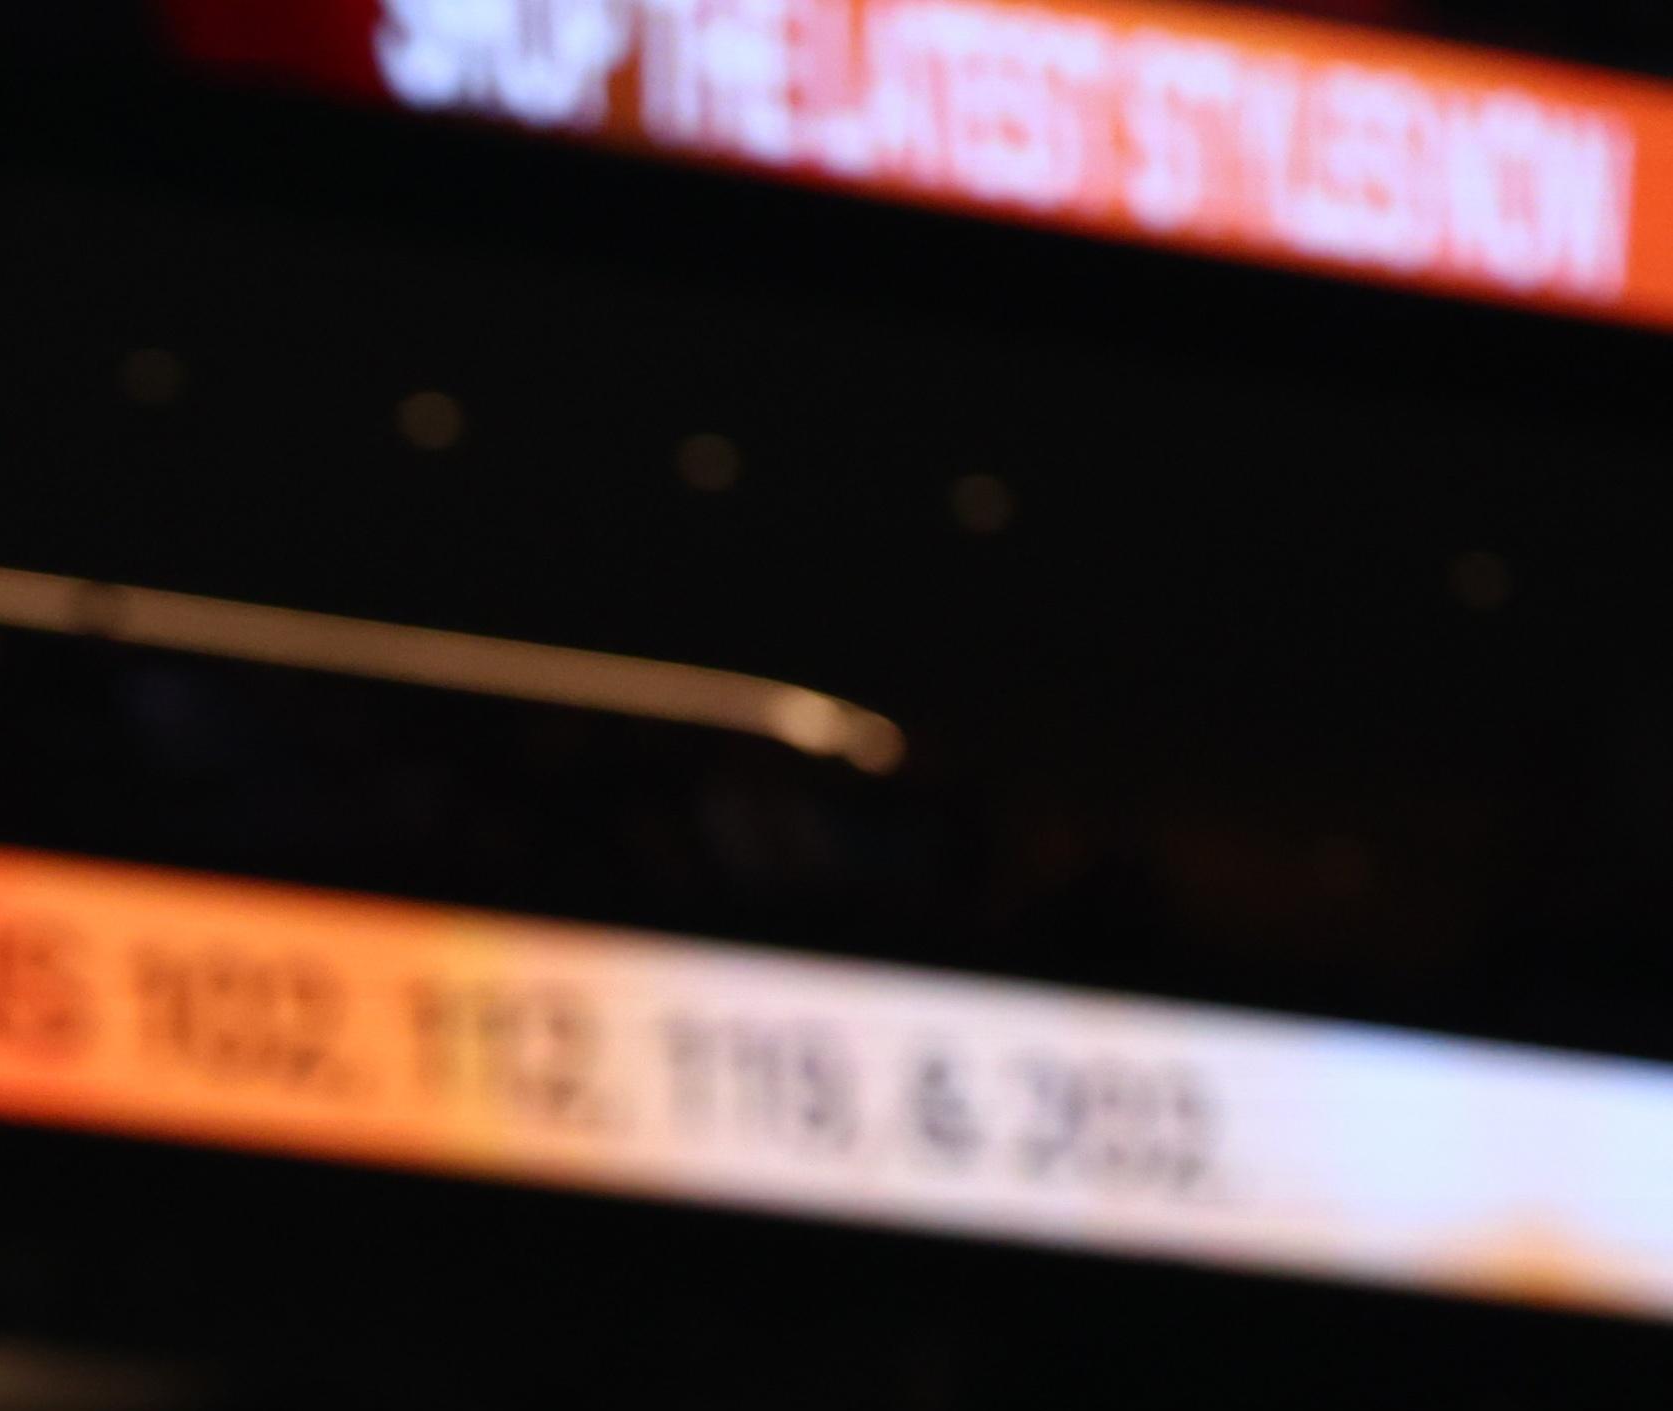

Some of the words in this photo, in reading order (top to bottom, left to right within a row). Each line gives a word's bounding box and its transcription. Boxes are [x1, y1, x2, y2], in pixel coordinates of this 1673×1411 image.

[1121, 28, 1441, 264] STYLES
[1445, 92, 1631, 292] NOW
[895, 1022, 985, 1170] &
